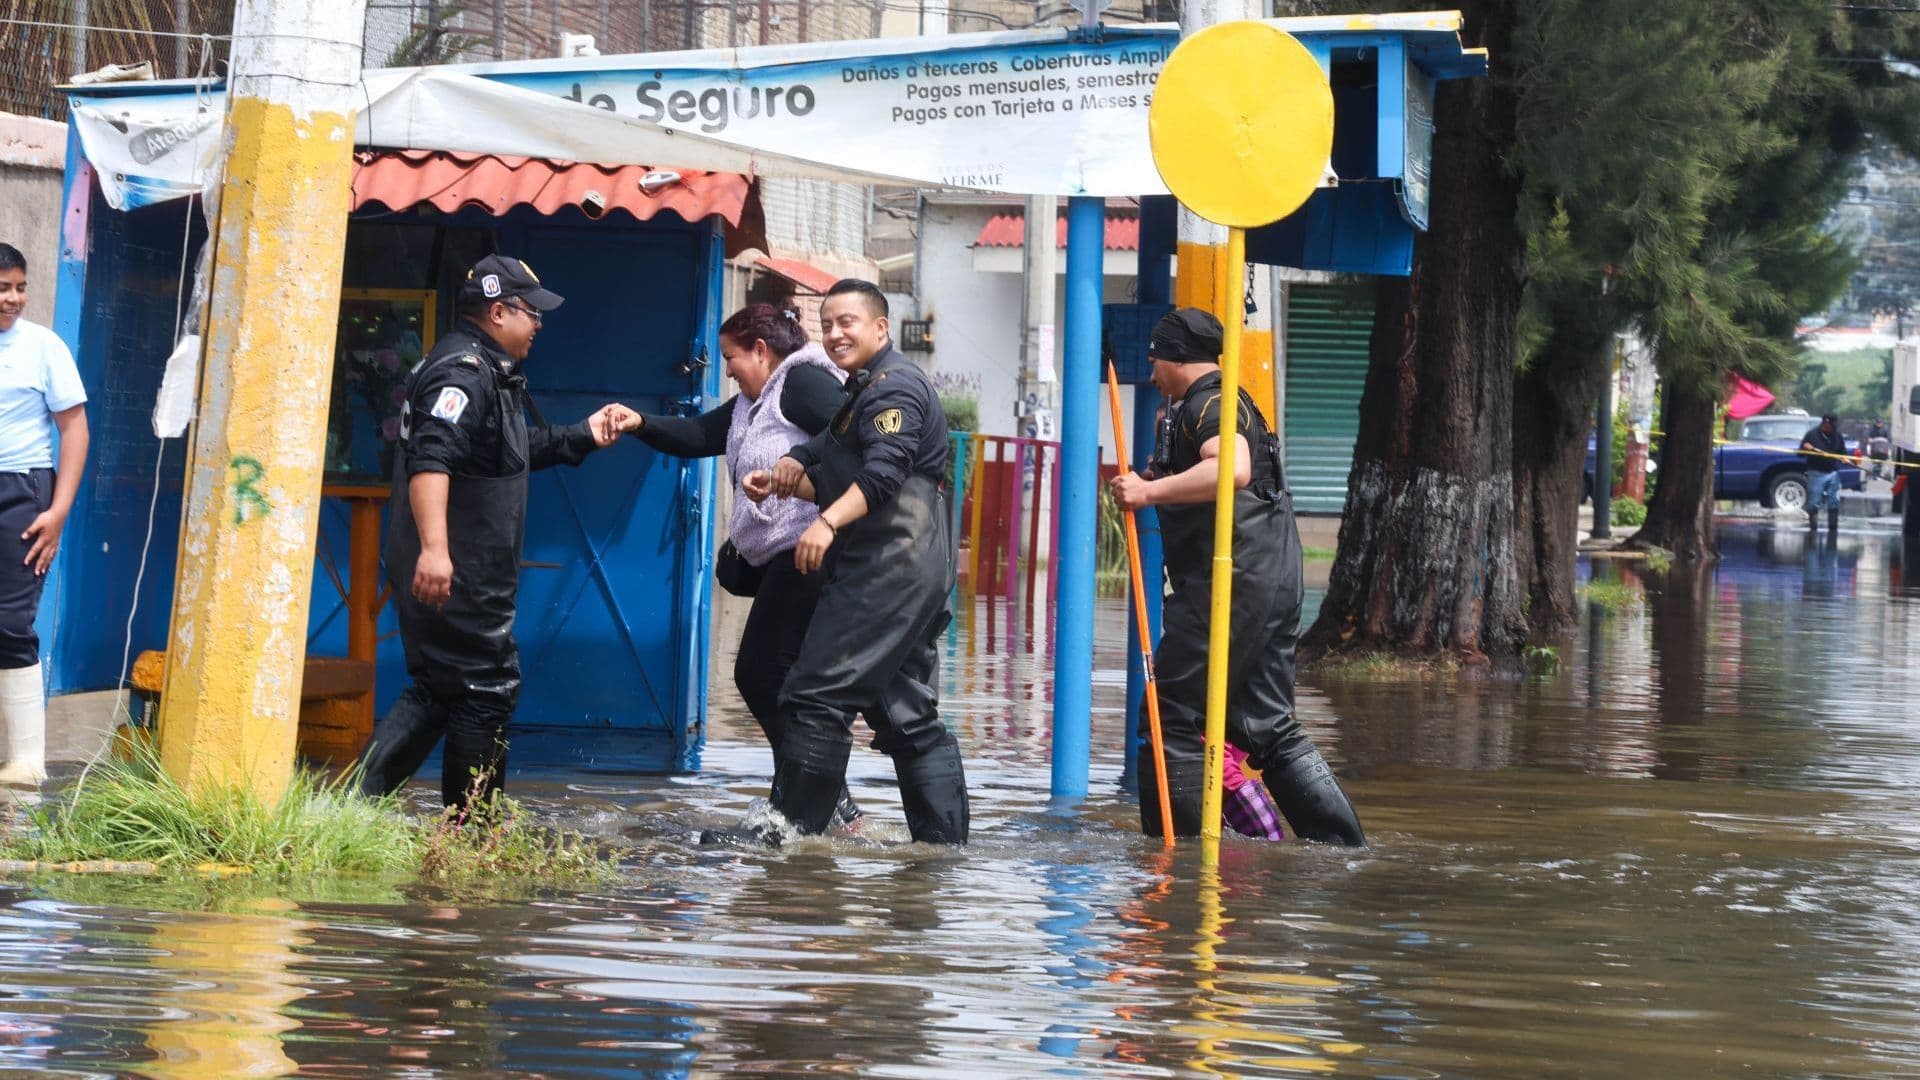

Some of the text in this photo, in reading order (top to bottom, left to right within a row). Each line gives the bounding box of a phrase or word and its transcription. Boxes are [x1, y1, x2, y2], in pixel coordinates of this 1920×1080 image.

[842, 65, 900, 83] Daños
[906, 65, 917, 78] a
[923, 60, 998, 78] terceros
[1011, 53, 1112, 72] Coberturas
[907, 84, 962, 103] Pagos
[969, 75, 1070, 96] mensuales,
[636, 80, 815, 133] Seguro
[892, 106, 947, 125] Pagos
[954, 104, 986, 118] con
[992, 97, 1055, 118] Tarjeta
[1062, 99, 1073, 111] a
